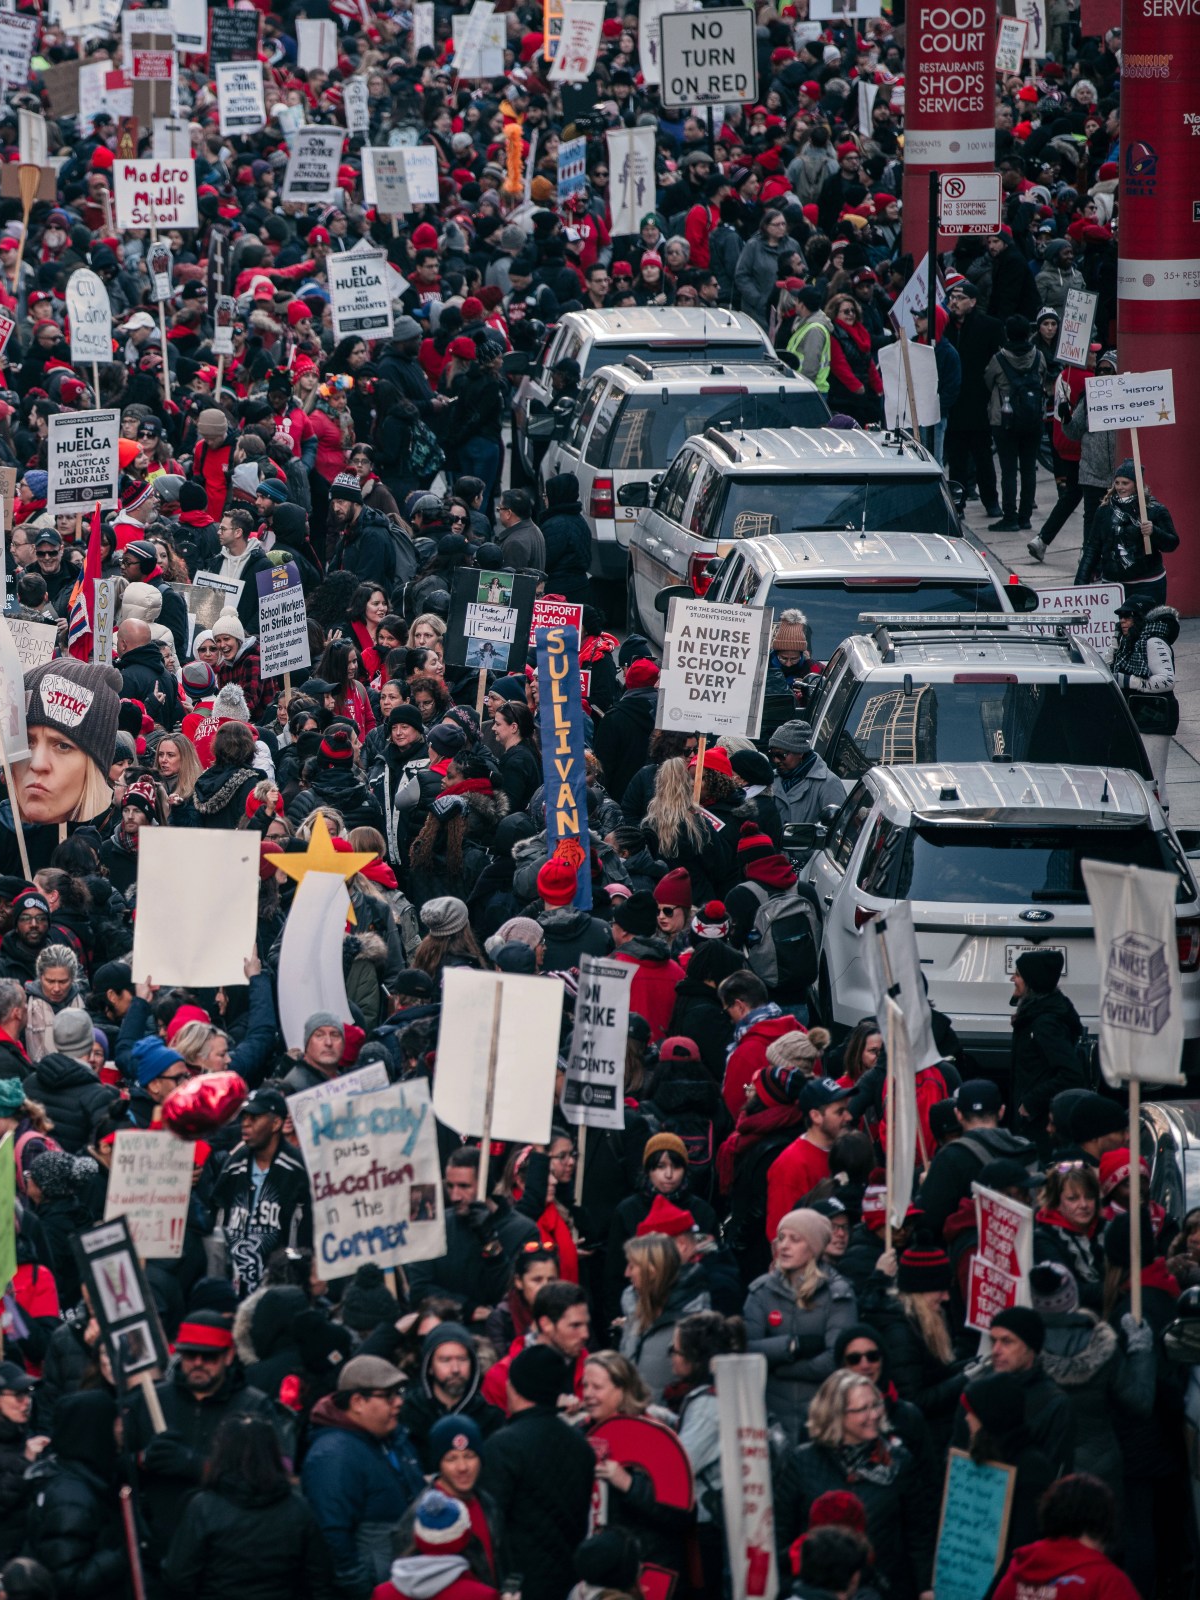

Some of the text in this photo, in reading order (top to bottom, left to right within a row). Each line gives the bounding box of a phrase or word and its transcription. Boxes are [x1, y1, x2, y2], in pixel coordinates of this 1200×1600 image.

[920, 8, 985, 29] FOOD
[691, 22, 723, 40] NO
[920, 33, 985, 53] COURT
[681, 48, 734, 67] TURN
[919, 61, 984, 74] RESTAURANTS
[671, 75, 747, 98] ON RED
[919, 76, 984, 96] SHOPS
[919, 97, 984, 113] SERVICES
[124, 163, 189, 183] Madero
[134, 189, 185, 206] Middle
[351, 265, 367, 277] EN
[335, 276, 382, 290] HUELGA
[75, 427, 93, 438] EN
[56, 438, 111, 453] HUELGA
[57, 457, 110, 468] PRACTICAS
[59, 474, 110, 485] LABORALES
[63, 466, 106, 477] INJUSTAS
[272, 578, 289, 590] SEIU
[479, 605, 500, 614] Under
[1043, 593, 1110, 609] PARKING
[260, 599, 305, 621] School Workers
[535, 604, 577, 616] SUPPORT
[690, 612, 746, 624] STUDENTS DESERVE
[710, 608, 738, 616] SCHOOLS
[478, 624, 502, 633] Funded
[680, 625, 751, 645] A NURSE
[677, 640, 751, 660] IN EVERY
[677, 655, 746, 676] SCHOOL
[684, 671, 736, 689] EVERY
[46, 690, 87, 717] STRIKE
[689, 687, 727, 704] DAY!
[546, 628, 581, 837] SULLIVAN
[310, 1087, 429, 1158] Nobody
[333, 1142, 371, 1166] puts
[313, 1160, 415, 1201] Education
[321, 1219, 410, 1264] Corner
